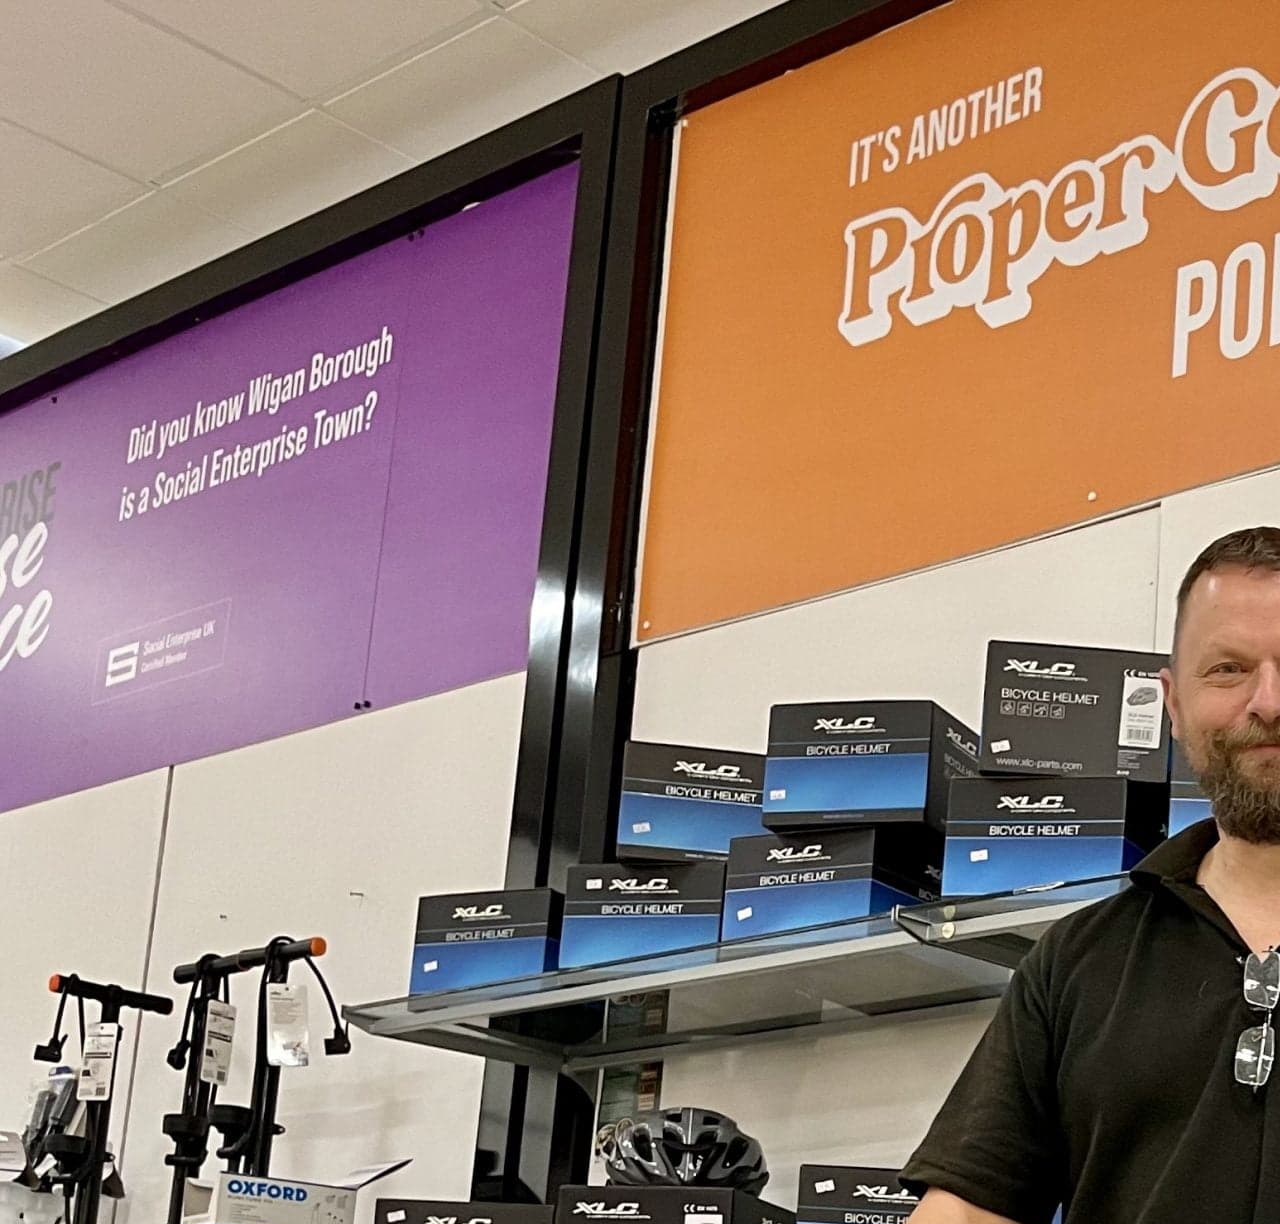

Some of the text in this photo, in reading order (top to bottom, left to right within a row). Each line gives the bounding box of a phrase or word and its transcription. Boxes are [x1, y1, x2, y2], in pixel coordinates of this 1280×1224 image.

[848, 66, 1043, 188] IT'S ANOTHER
[838, 135, 1178, 347] Proper
[127, 326, 393, 463] Did you know Wigan Borough
[119, 390, 378, 522] is a Social Enterprise Town?
[1003, 659, 1075, 676] XLC
[1001, 688, 1099, 705] BICYCLE HELMET
[814, 717, 876, 732] XLC
[806, 743, 890, 756] BICYCLE HELMET
[673, 761, 741, 777] XLC
[665, 785, 757, 803] BICYCLE HELMET
[997, 795, 1064, 808] XLC
[989, 824, 1081, 836] BICYCLE HELMET
[767, 844, 823, 862] XLC
[608, 878, 670, 892] XLC
[760, 870, 835, 886] BICYCLE HELMET
[451, 904, 503, 919] XLC
[601, 904, 683, 915] BICYCLE HELMET
[482, 928, 515, 940] HELMET
[228, 1179, 308, 1202] OXFORD
[573, 1202, 639, 1215] XLC
[845, 1213, 894, 1224] BICYCLE
